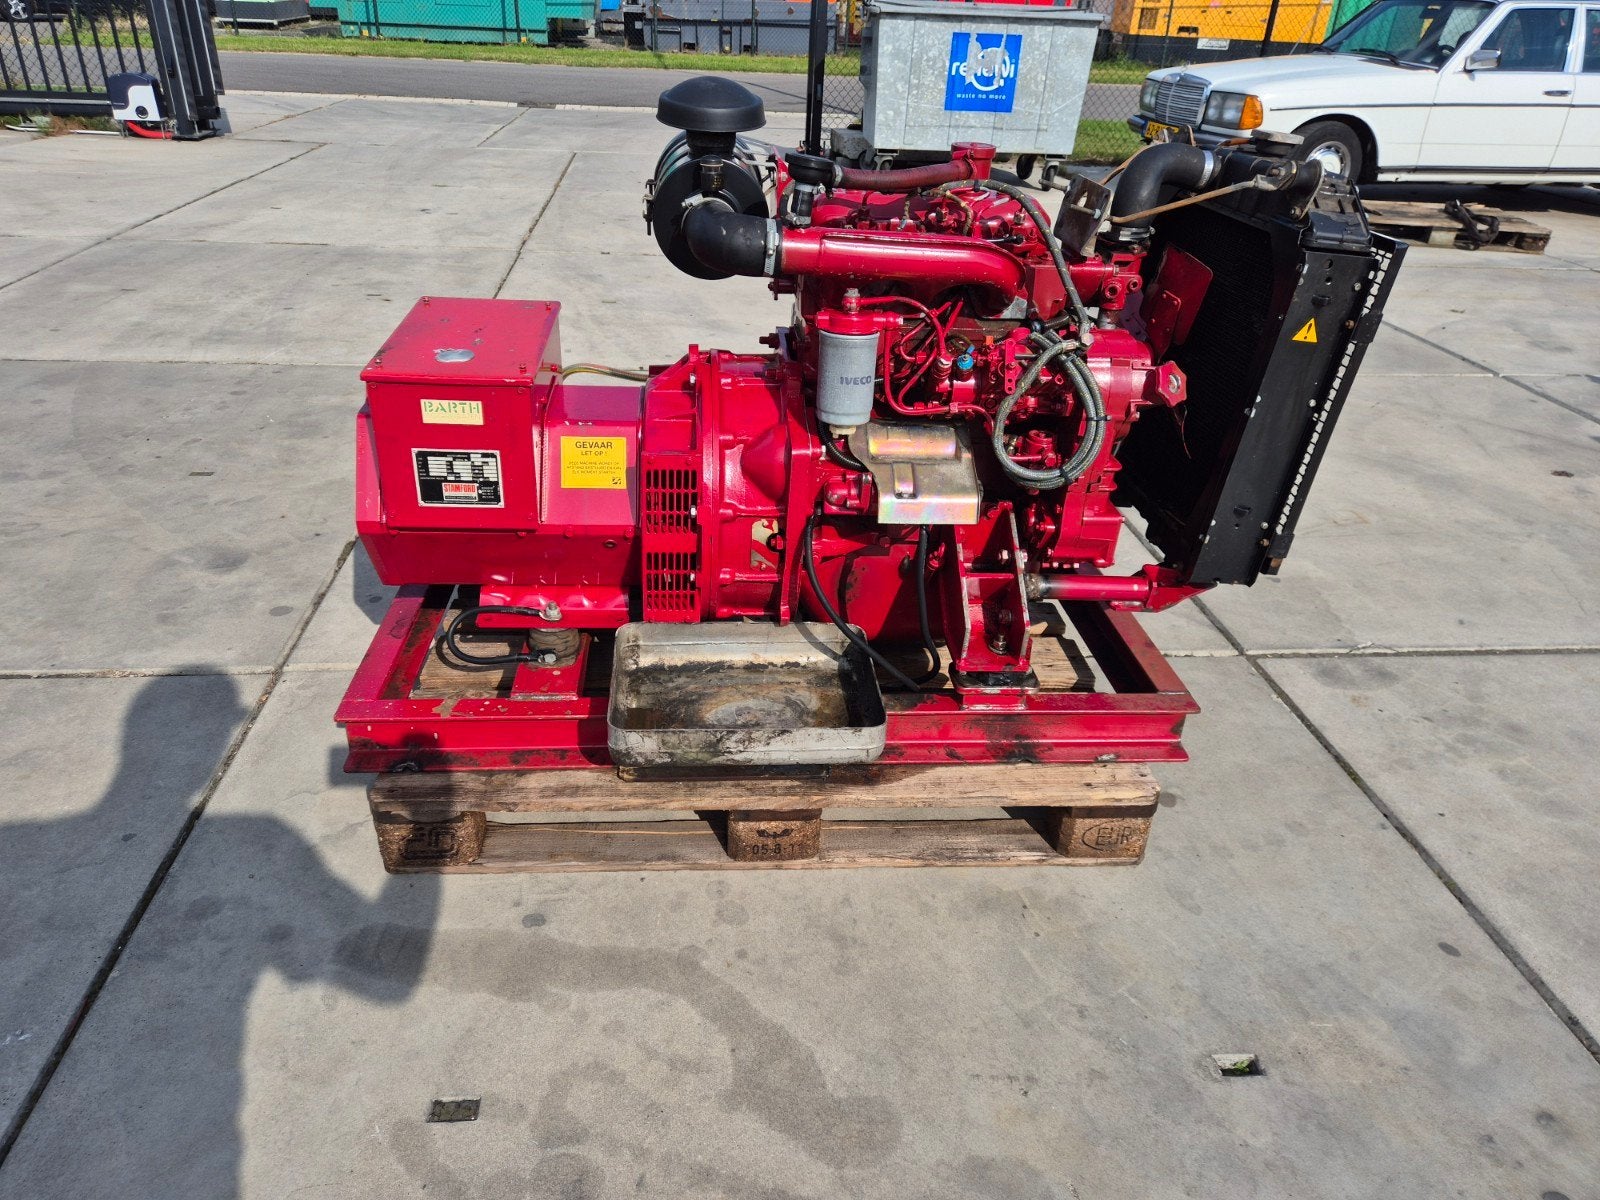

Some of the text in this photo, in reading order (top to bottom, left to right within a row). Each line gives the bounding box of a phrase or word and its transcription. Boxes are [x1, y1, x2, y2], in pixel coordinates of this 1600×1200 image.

[838, 374, 872, 385] IVECO
[423, 401, 480, 414] BARTH
[575, 441, 613, 449] GEVAAR
[443, 483, 476, 493] STAMFORD
